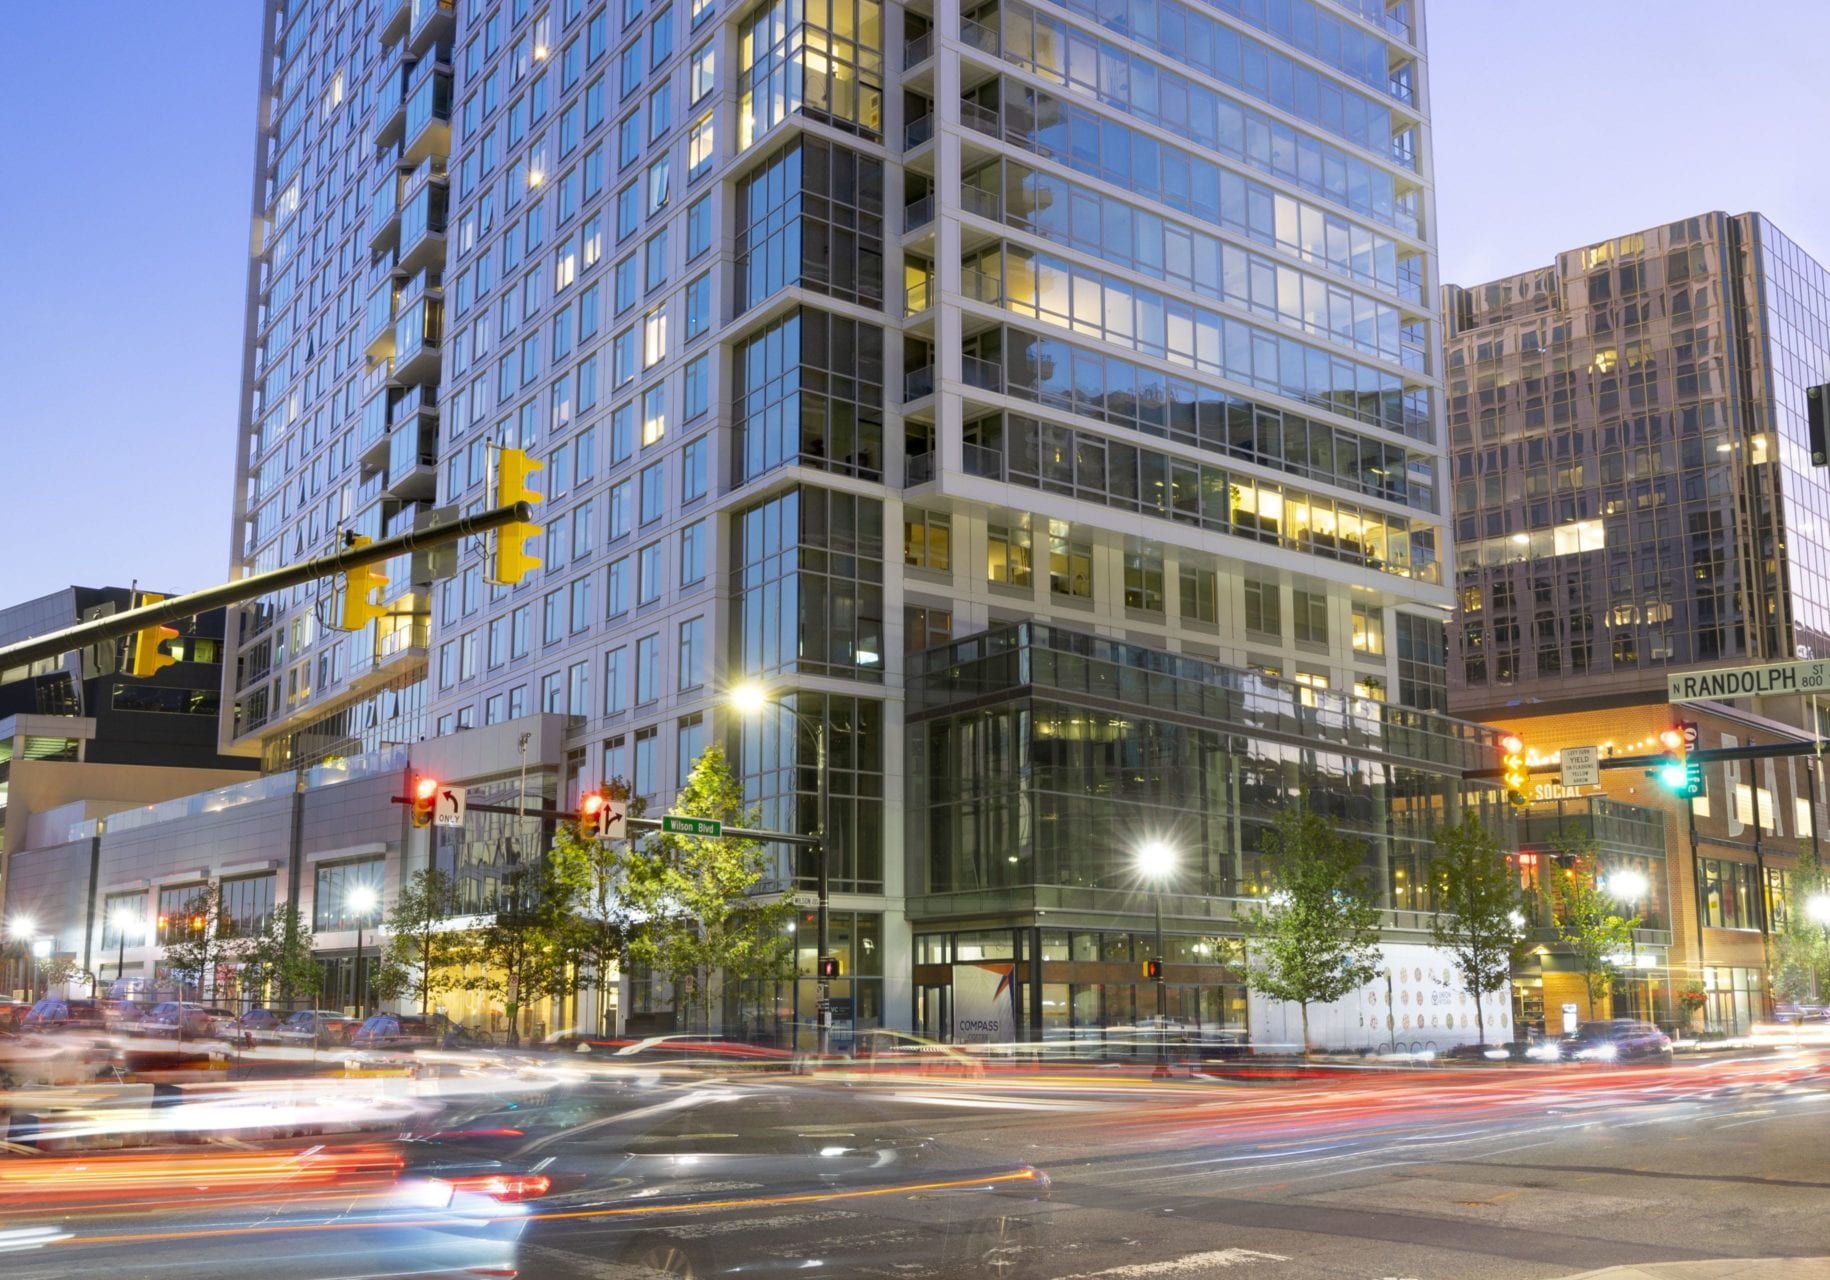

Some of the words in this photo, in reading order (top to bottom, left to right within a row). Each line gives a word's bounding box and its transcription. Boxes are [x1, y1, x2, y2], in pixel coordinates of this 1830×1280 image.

[1673, 683, 1680, 694] N
[1684, 667, 1796, 698] RANDOLPH
[1812, 664, 1824, 675] ST
[1801, 676, 1823, 687] 800
[1535, 783, 1582, 800] SOCIAL
[671, 820, 693, 831] Wilson
[698, 823, 714, 833] Blvd
[960, 1020, 999, 1031] COMPASS
